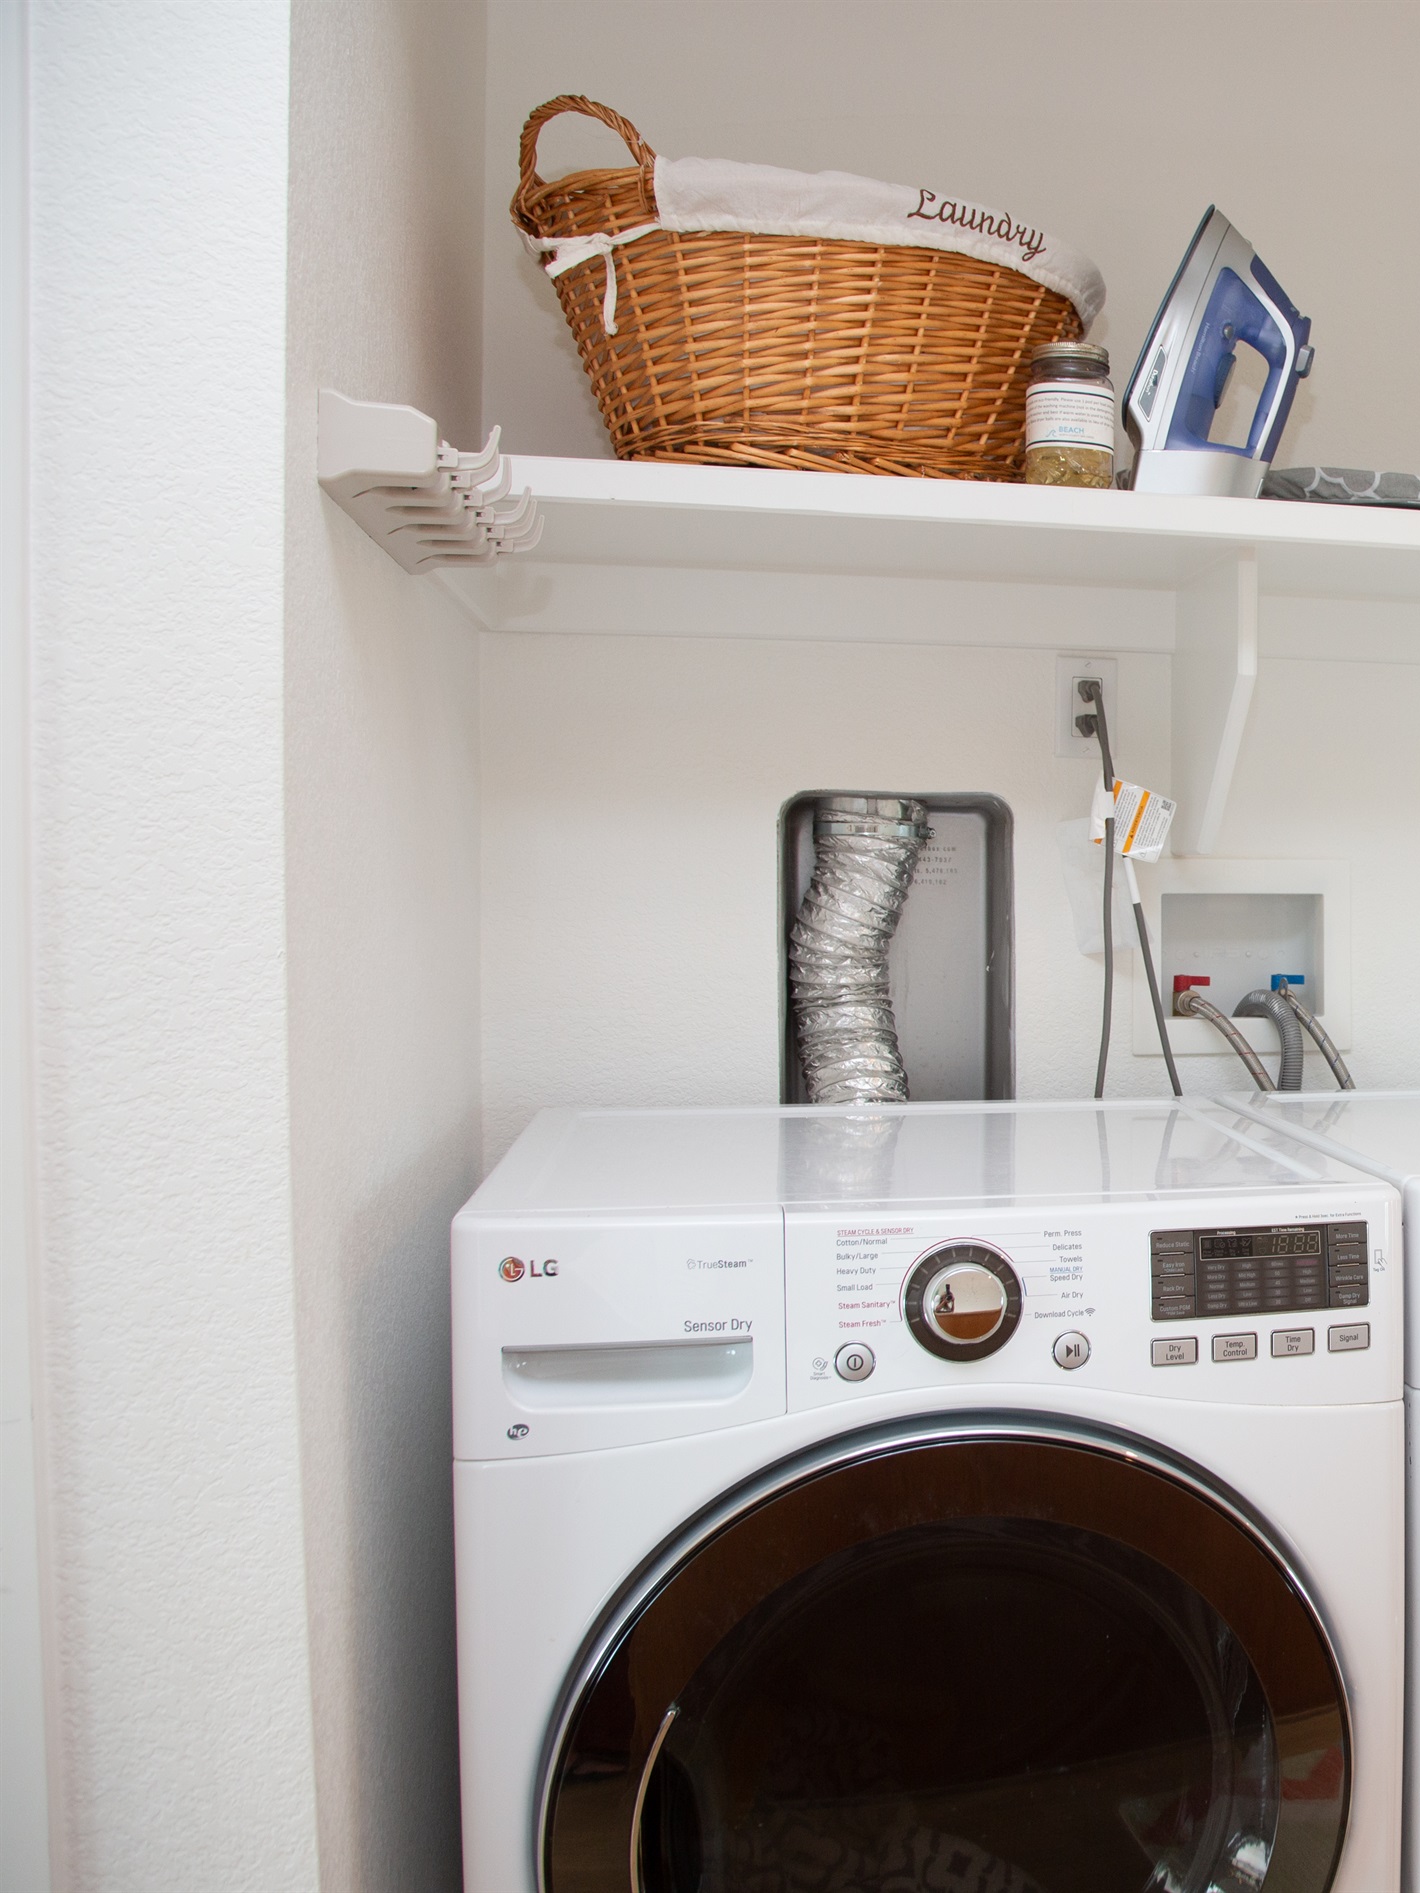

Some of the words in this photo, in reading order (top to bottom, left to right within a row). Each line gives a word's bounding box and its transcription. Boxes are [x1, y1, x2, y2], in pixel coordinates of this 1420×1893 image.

[907, 188, 1047, 262] Laundry
[1059, 426, 1085, 434] BEACH
[1063, 1229, 1082, 1237] Press
[836, 1238, 888, 1246] Cotton/Normal
[1052, 1243, 1083, 1251] Delicates
[836, 1253, 878, 1261] Bulky/Large
[529, 1259, 560, 1278] LG
[836, 1268, 858, 1276] Heavy
[860, 1267, 877, 1275] Duty
[838, 1302, 860, 1310] Steam
[1034, 1311, 1065, 1319] Download
[1067, 1310, 1084, 1318] Cycle
[684, 1320, 727, 1333] Sensor
[731, 1318, 753, 1332] Dry
[1285, 1335, 1301, 1343] Time
[1339, 1333, 1359, 1343] Signal
[1168, 1344, 1182, 1353] Dry
[1287, 1343, 1299, 1352] Dry
[1165, 1352, 1185, 1361] Level
[1223, 1348, 1248, 1357] Control
